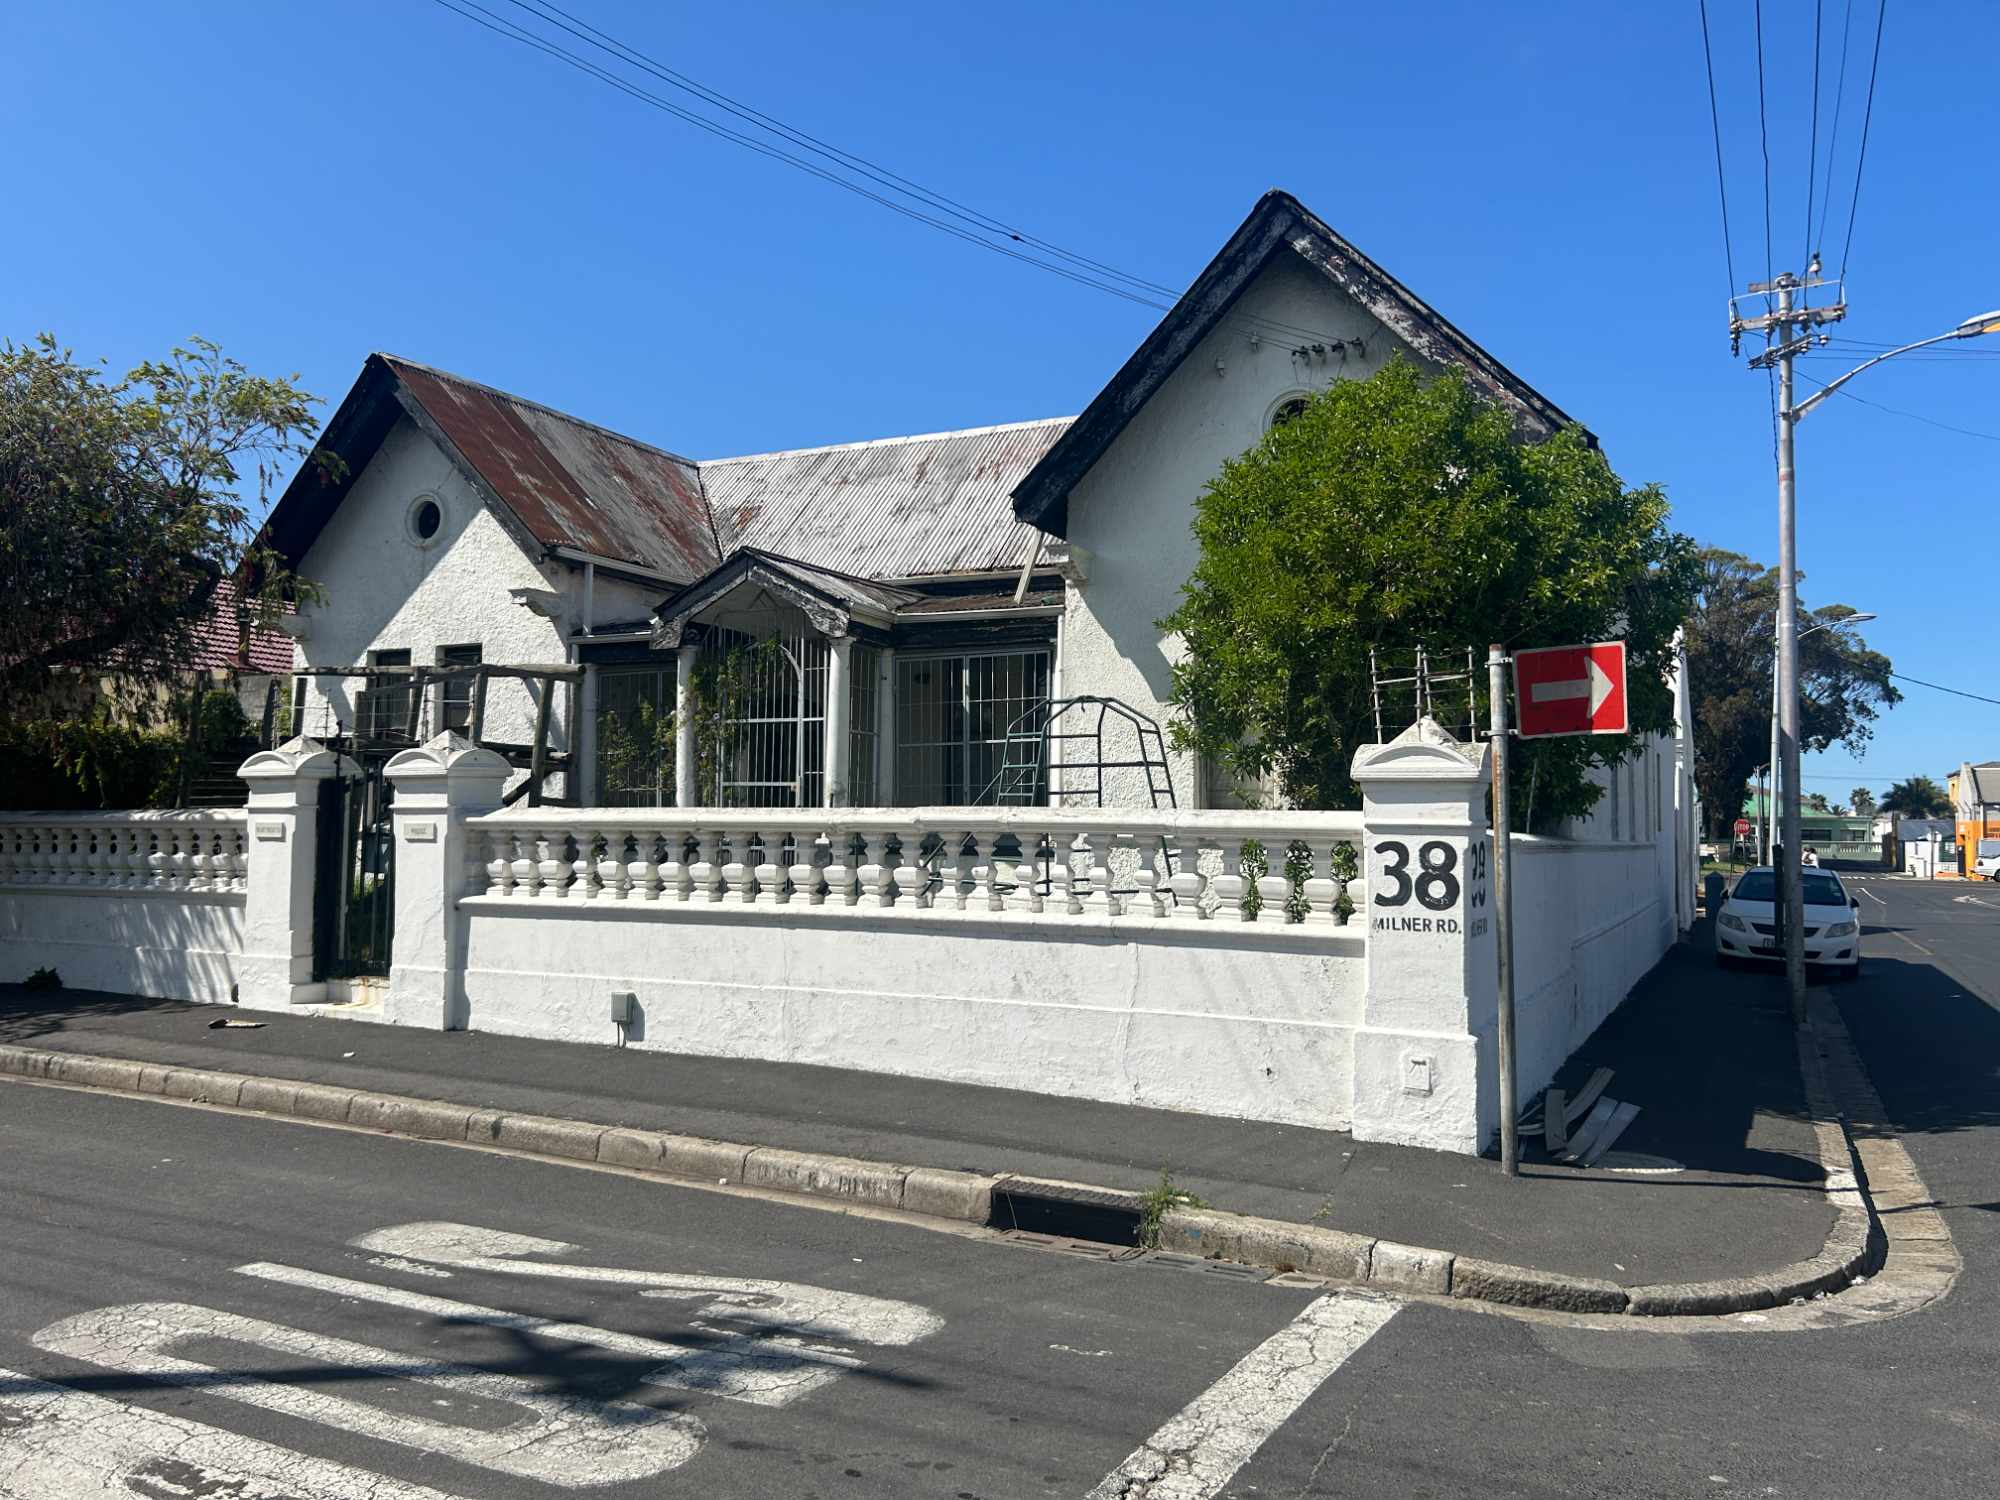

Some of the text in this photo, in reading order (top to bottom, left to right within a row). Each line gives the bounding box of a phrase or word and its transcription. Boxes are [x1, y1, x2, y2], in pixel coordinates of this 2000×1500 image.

[1374, 840, 1460, 911] 38
[1372, 916, 1432, 933] MILNER
[1436, 918, 1463, 935] RD.
